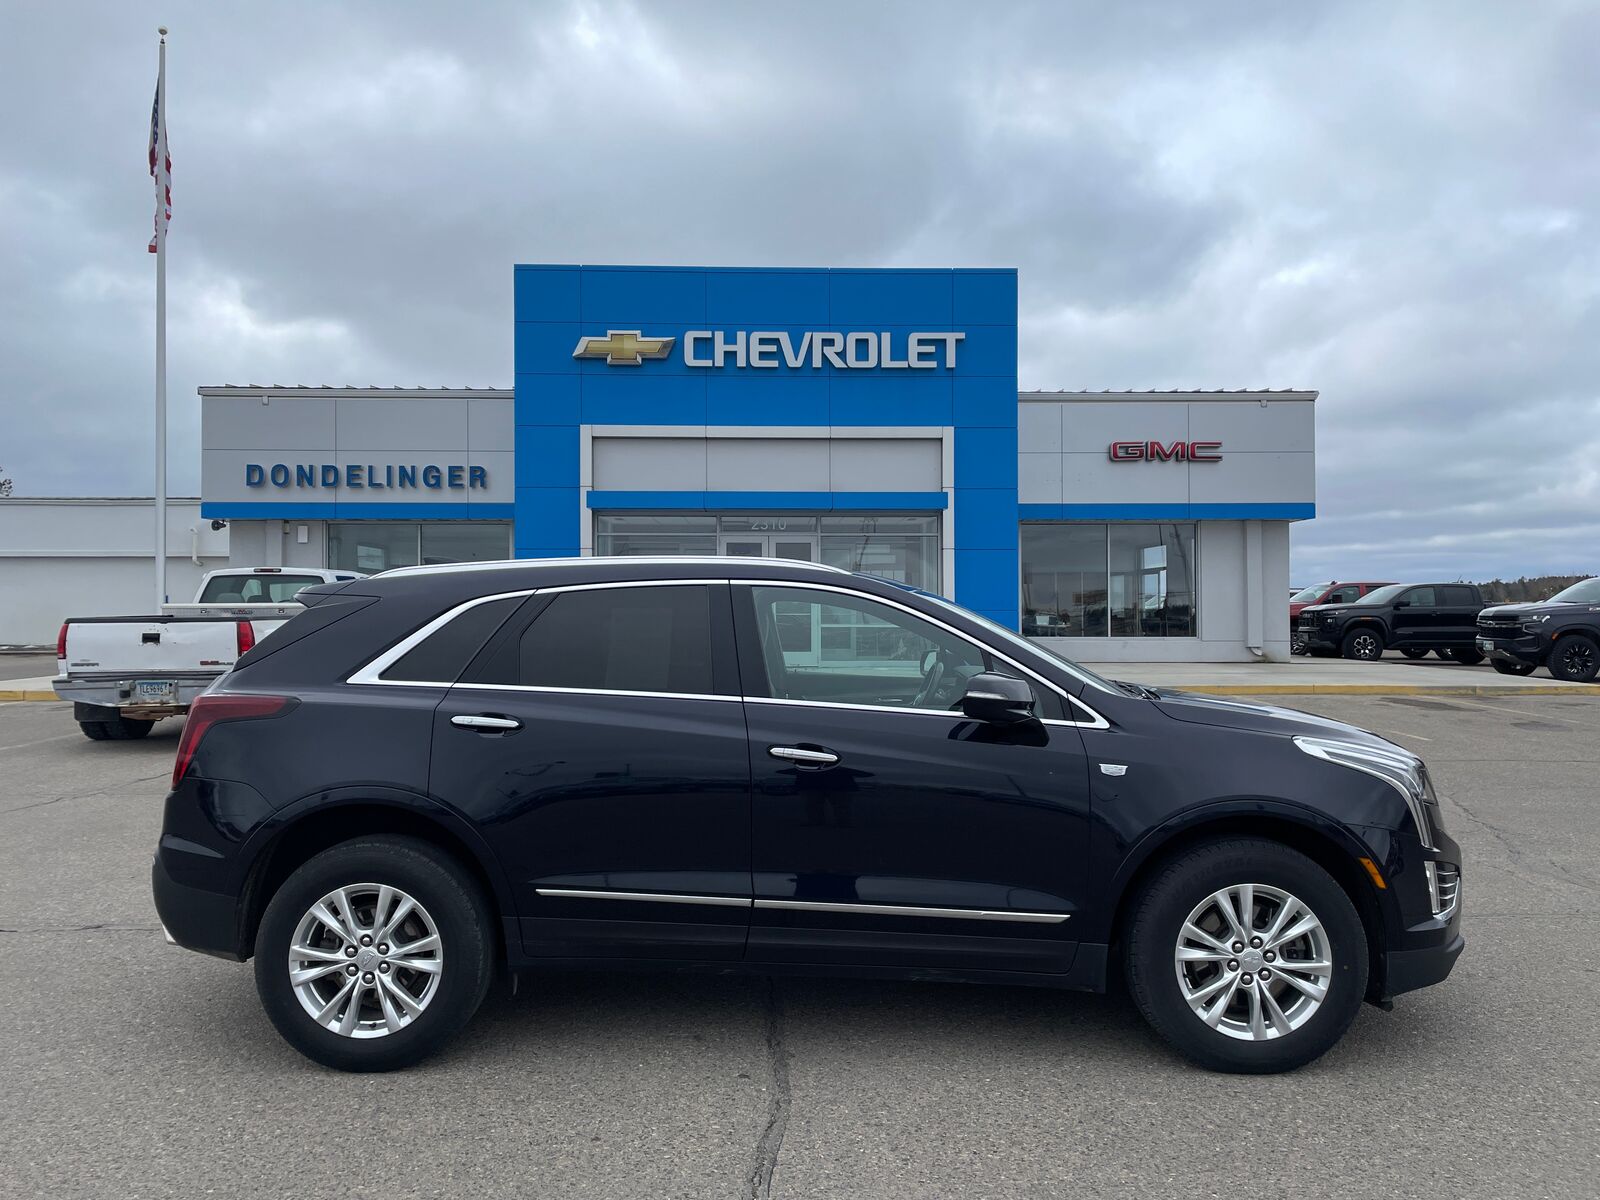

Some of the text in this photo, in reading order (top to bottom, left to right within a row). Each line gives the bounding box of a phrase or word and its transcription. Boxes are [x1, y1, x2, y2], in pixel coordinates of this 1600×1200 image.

[683, 330, 966, 369] CHEVROLET
[1109, 440, 1222, 462] GMC
[245, 463, 488, 490] DONDELINGER
[751, 518, 787, 530] 2310
